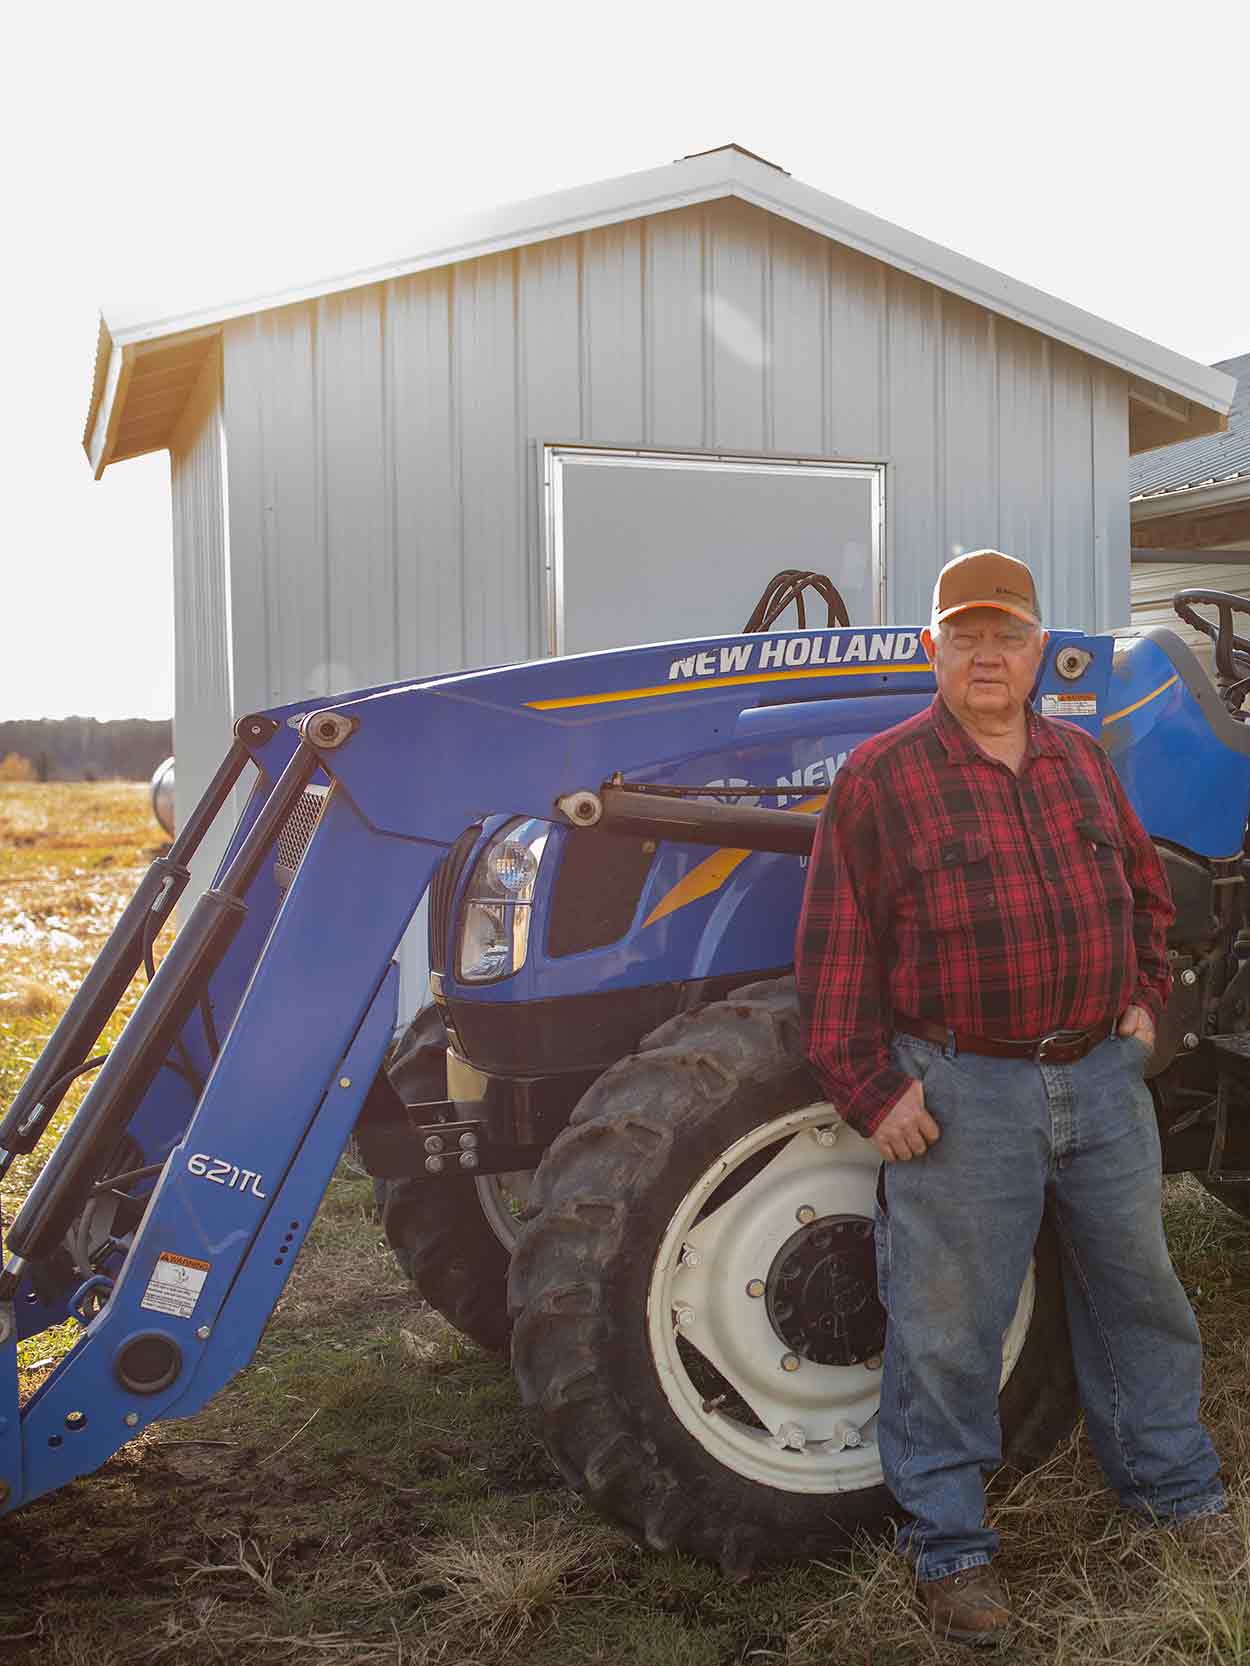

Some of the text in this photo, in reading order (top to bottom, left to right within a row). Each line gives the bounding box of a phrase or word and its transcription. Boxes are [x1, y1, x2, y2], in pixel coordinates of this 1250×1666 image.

[669, 632, 918, 680] NEW HOLLAND
[188, 1153, 266, 1198] 621TL
